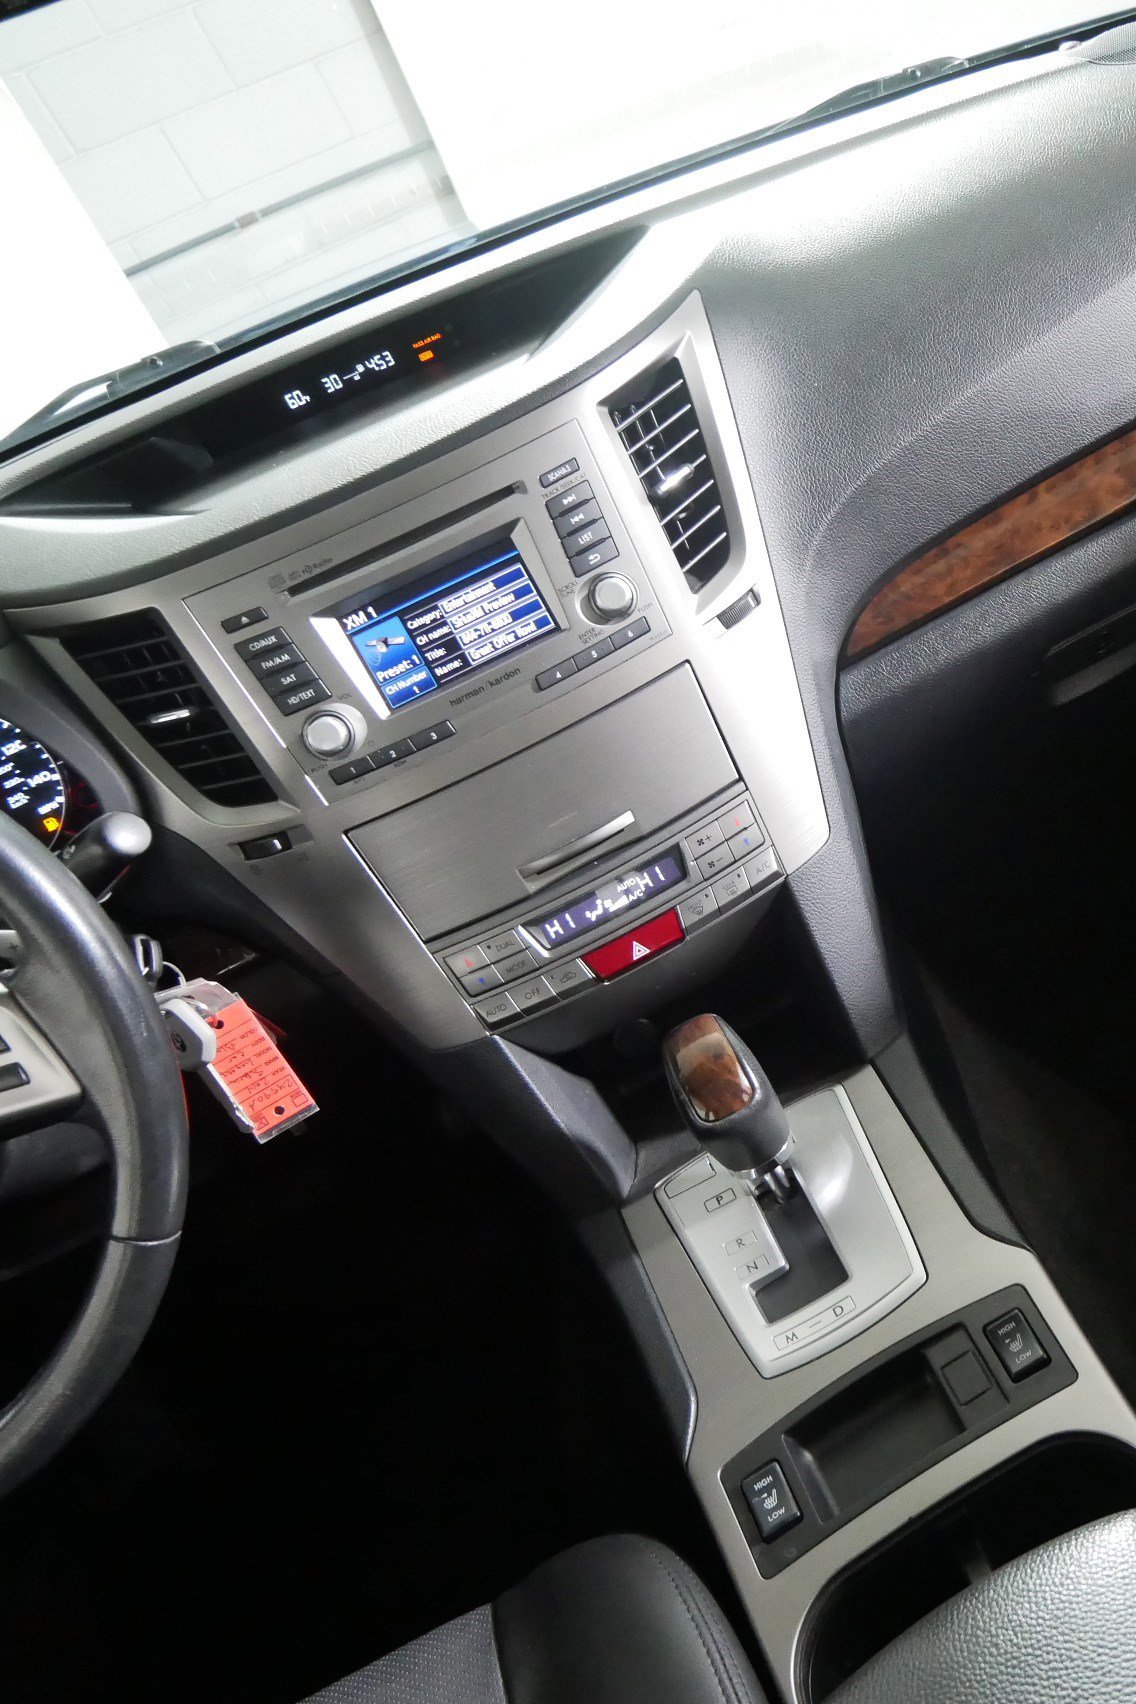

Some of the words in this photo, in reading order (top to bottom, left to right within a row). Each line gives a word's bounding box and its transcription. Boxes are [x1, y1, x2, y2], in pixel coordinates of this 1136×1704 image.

[577, 531, 594, 545] LIST
[407, 609, 443, 630] Category:
[444, 582, 497, 612] Entertainment
[343, 610, 368, 631] XM
[367, 606, 378, 618] 1
[416, 636, 429, 646] CH
[428, 625, 452, 641] name:
[484, 592, 516, 613] Preview
[628, 629, 634, 637] 6
[249, 635, 277, 651] CD/AUX
[261, 653, 291, 670] FM/AM
[425, 647, 448, 661] Title:
[434, 659, 463, 676] Name:
[469, 641, 495, 660] Great
[492, 632, 516, 649] Offer
[591, 650, 598, 659] 5
[376, 659, 414, 682] Preset:
[411, 655, 421, 665] 1
[555, 671, 562, 679] 4
[281, 673, 297, 685] SAT
[385, 686, 398, 695] CH
[397, 671, 427, 690] Number
[287, 689, 316, 705] HD/TEXT
[431, 732, 437, 740] 3
[389, 750, 396, 758] 2
[27, 771, 52, 787] 140
[755, 860, 772, 875] A/C
[616, 877, 638, 891] AUTO
[627, 888, 643, 902] A/C
[494, 939, 516, 953] DUAL
[505, 958, 528, 975] MODE
[523, 986, 542, 1001] OFF
[484, 1002, 508, 1019] AUTO
[715, 1194, 724, 1205] P
[736, 1237, 746, 1248] R
[746, 1261, 759, 1273] N
[785, 1331, 799, 1344] M
[832, 1305, 845, 1317] D
[997, 1321, 1017, 1337] HIGH
[1015, 1349, 1033, 1364] LOW
[753, 1475, 774, 1491] HIGH
[767, 1507, 786, 1522] LOW
